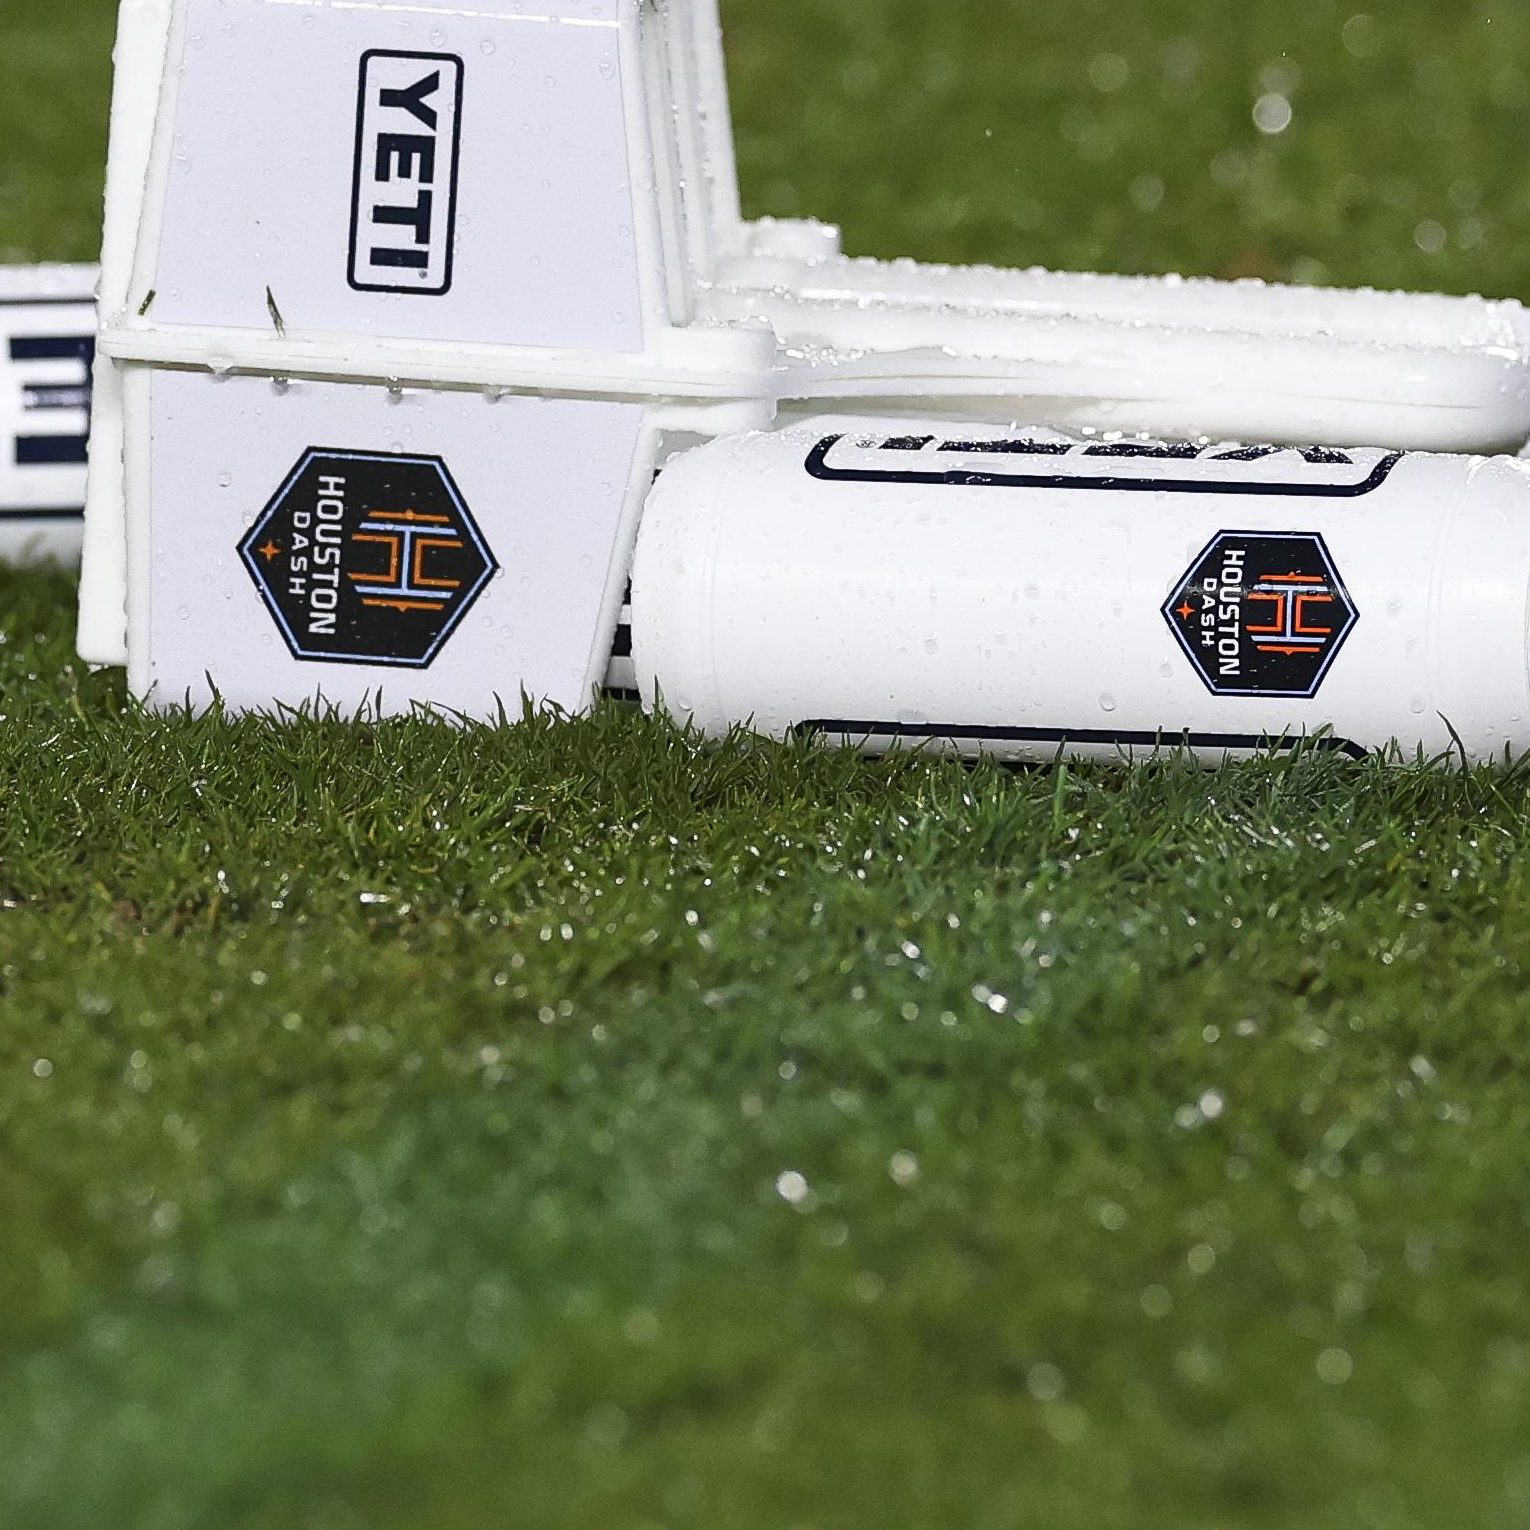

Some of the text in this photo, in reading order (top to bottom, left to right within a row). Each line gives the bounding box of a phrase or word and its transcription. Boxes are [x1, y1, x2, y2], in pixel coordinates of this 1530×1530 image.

[369, 69, 441, 269] YETI
[288, 510, 311, 596] DASH
[307, 474, 346, 636] HOUSTON
[1200, 576, 1218, 646] DASH
[1217, 549, 1247, 676] HOUSTON
